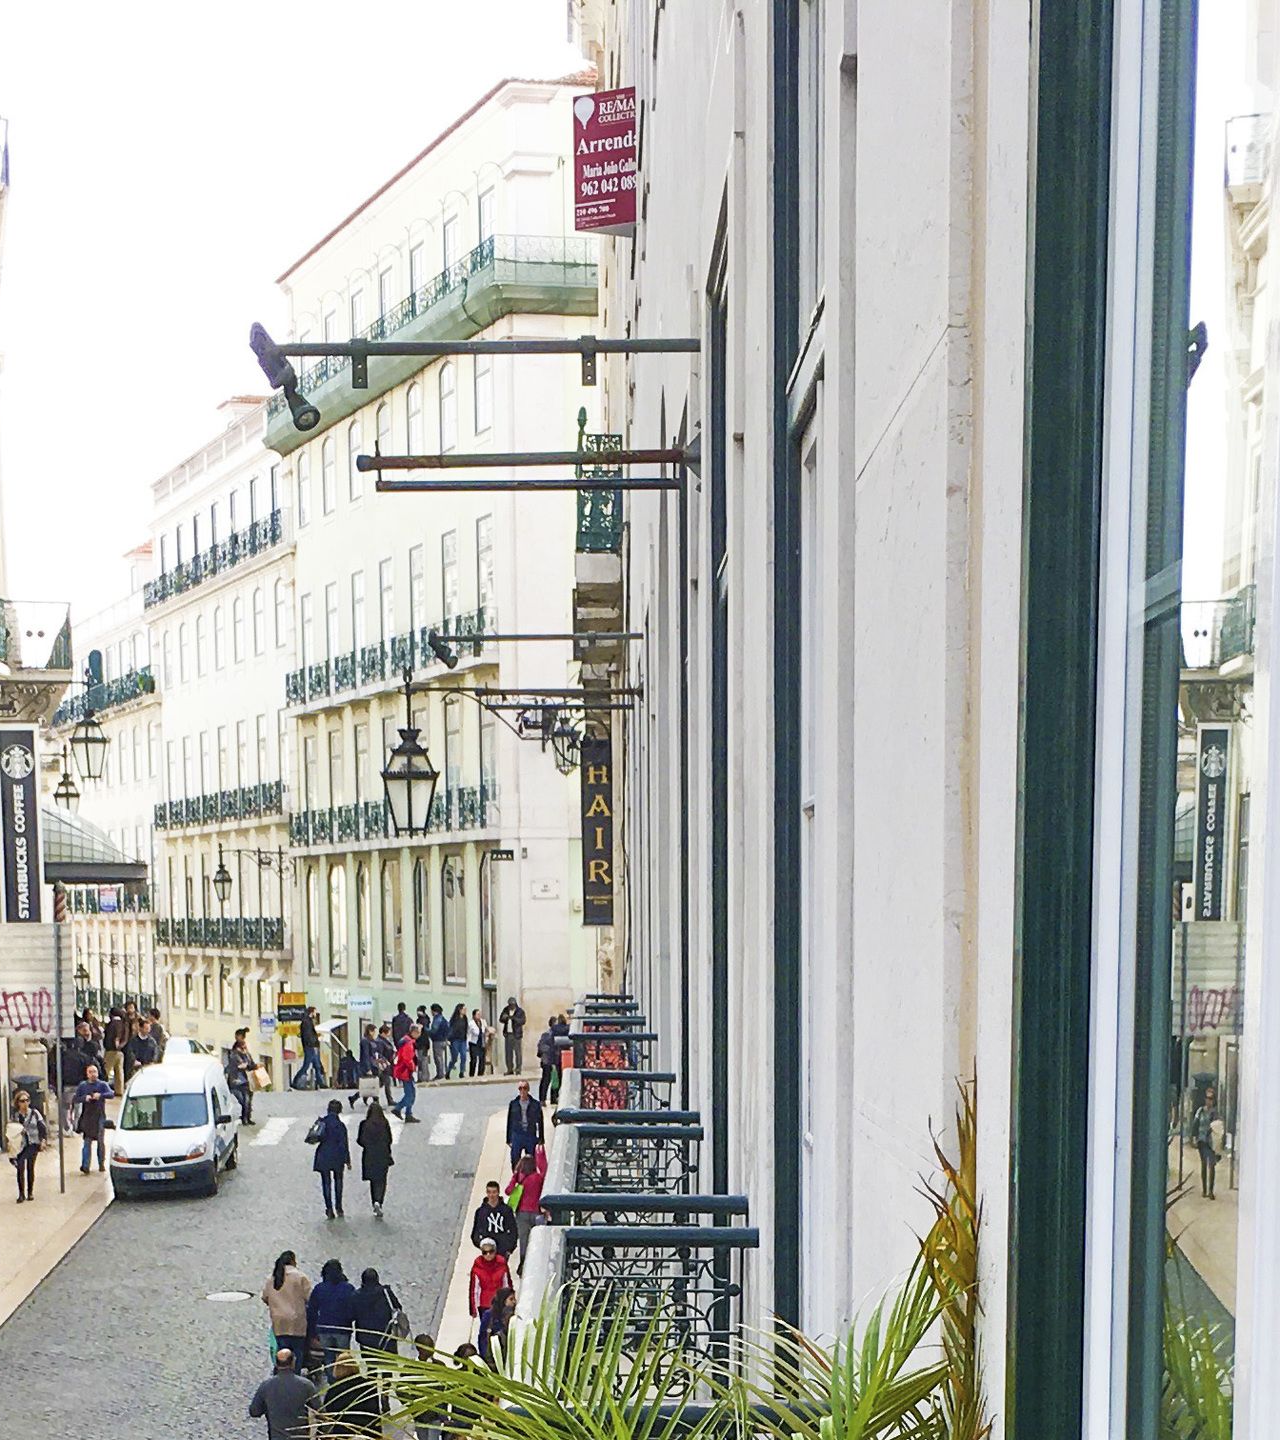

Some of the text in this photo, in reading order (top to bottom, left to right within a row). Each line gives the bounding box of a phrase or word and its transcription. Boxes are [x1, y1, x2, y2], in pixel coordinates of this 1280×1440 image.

[599, 98, 635, 115] RE/MA
[581, 181, 599, 196] 962
[601, 177, 619, 193] 042
[12, 784, 30, 919] STARBUCKS COFFEE
[585, 765, 612, 885] HAIR
